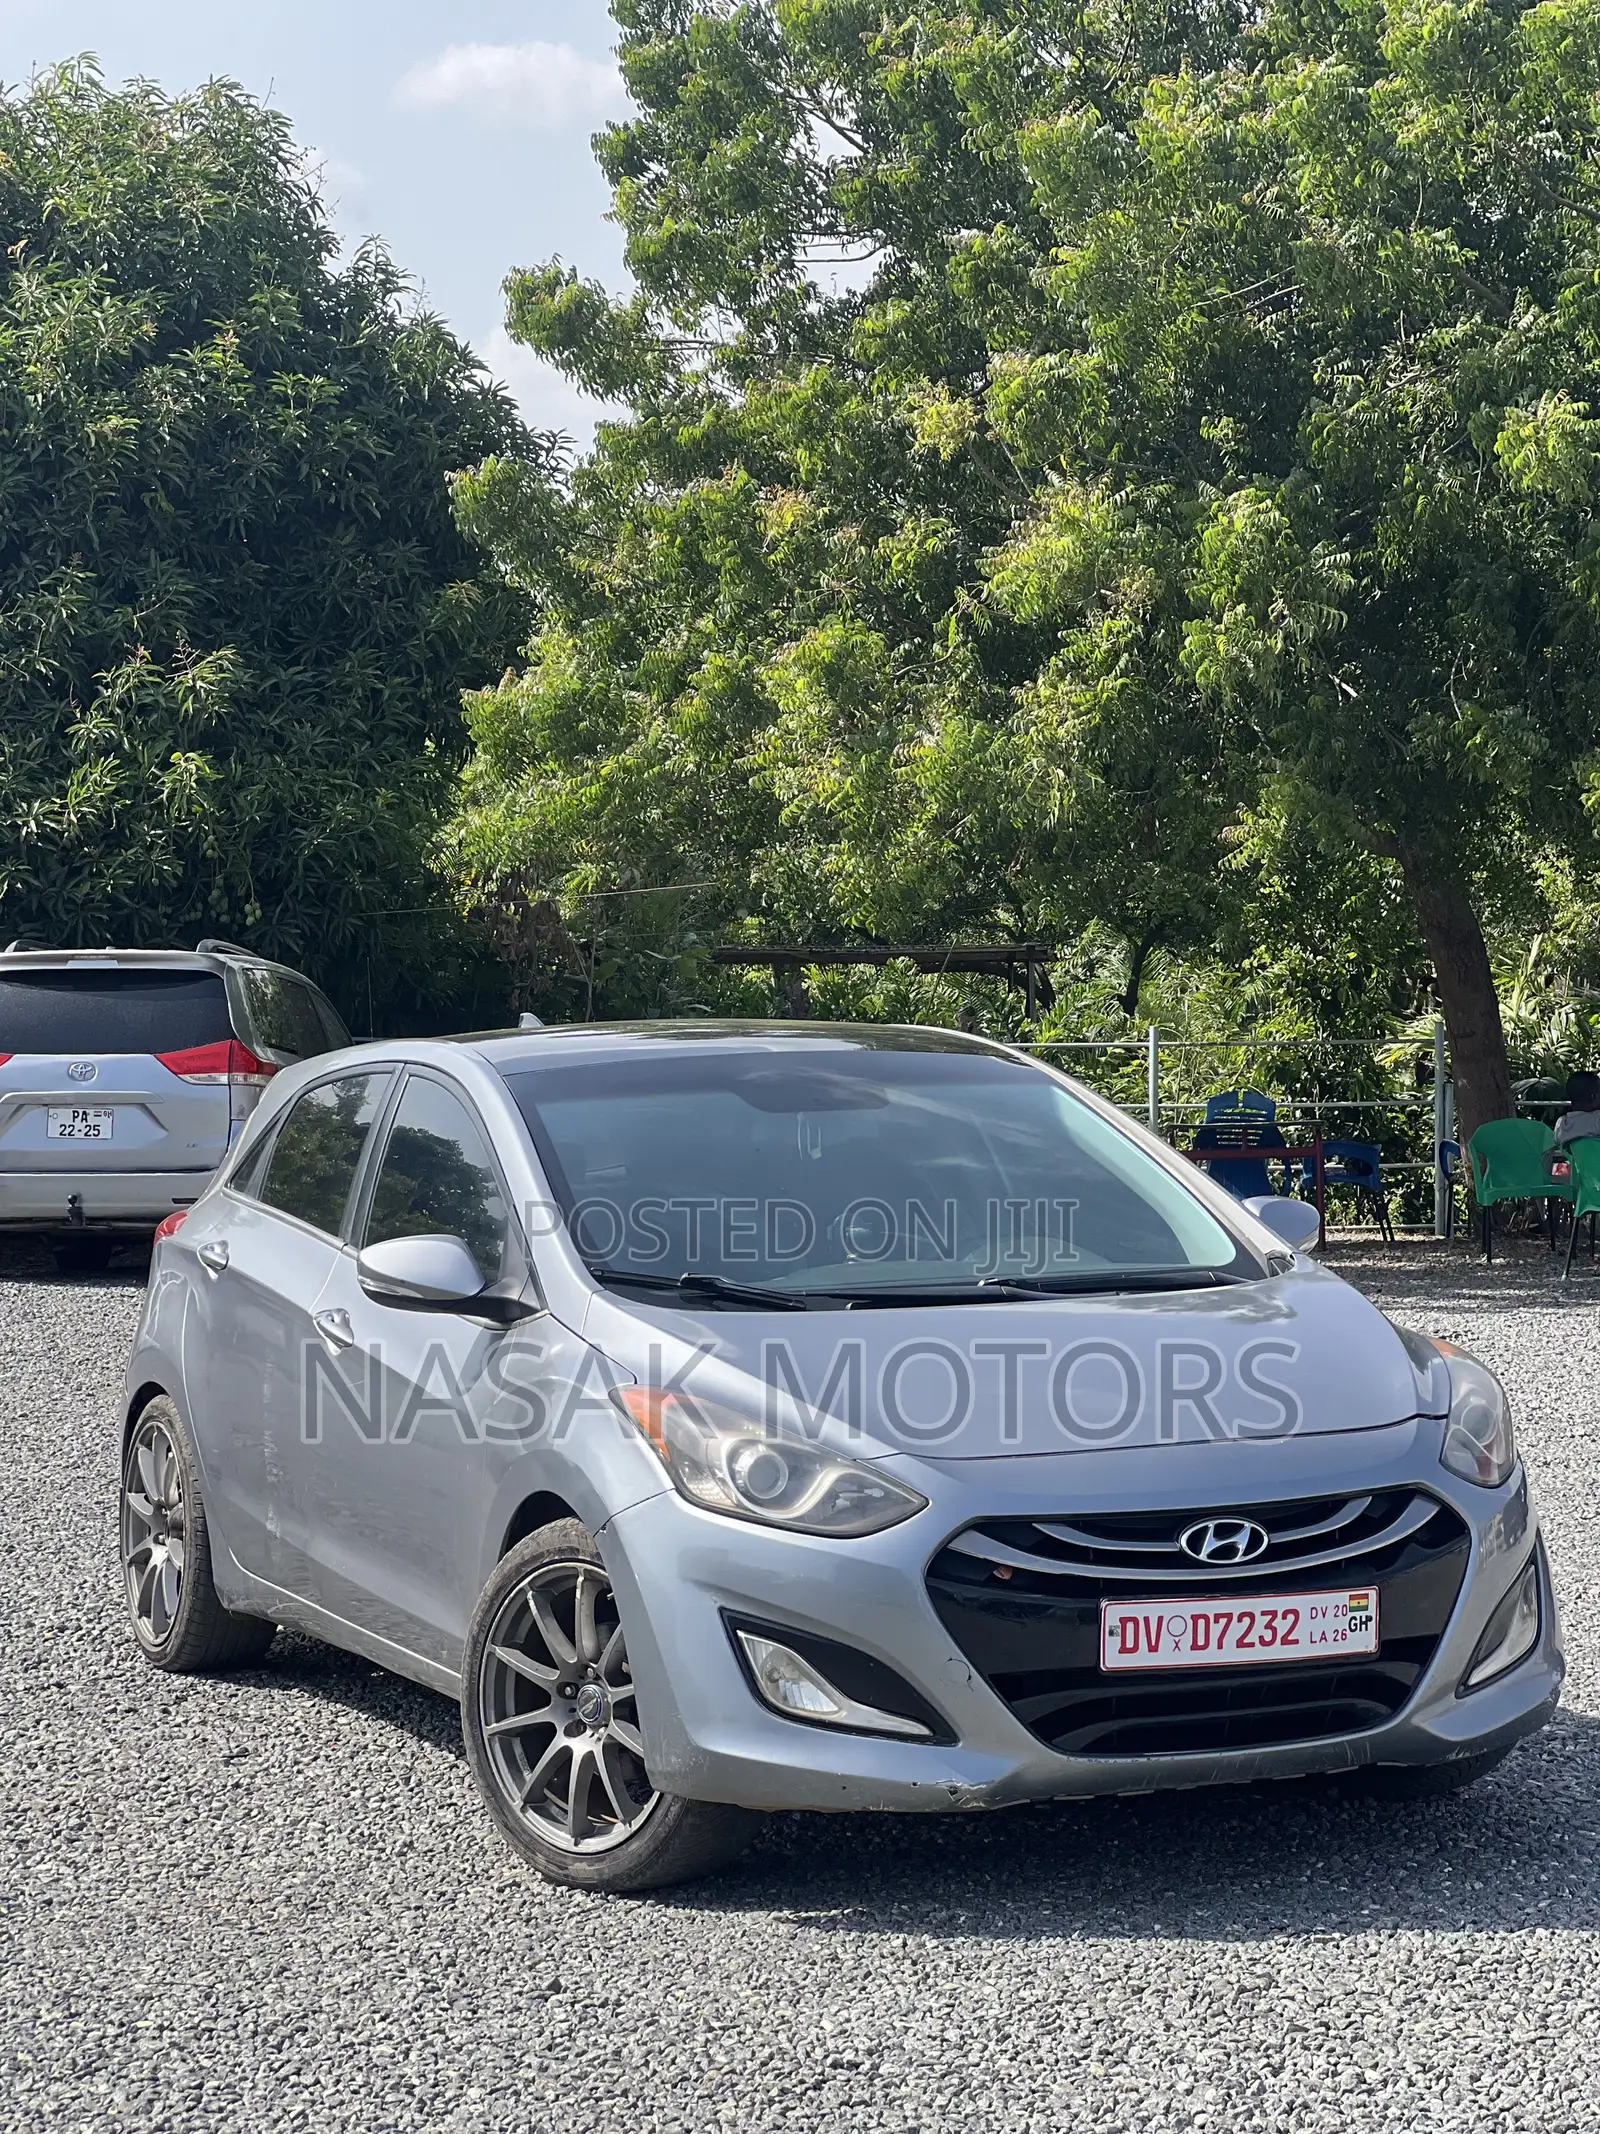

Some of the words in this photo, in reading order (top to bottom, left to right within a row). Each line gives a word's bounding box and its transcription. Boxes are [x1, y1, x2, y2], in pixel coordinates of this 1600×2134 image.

[72, 1110, 88, 1123] PA
[59, 1124, 101, 1137] 22-25
[1310, 1605, 1328, 1620] DV
[1333, 1603, 1348, 1618] 20
[1118, 1615, 1165, 1654] DV
[1190, 1608, 1301, 1651] D7232
[1348, 1615, 1369, 1633] GH
[1310, 1630, 1328, 1644] LA
[1332, 1628, 1348, 1642] 26
